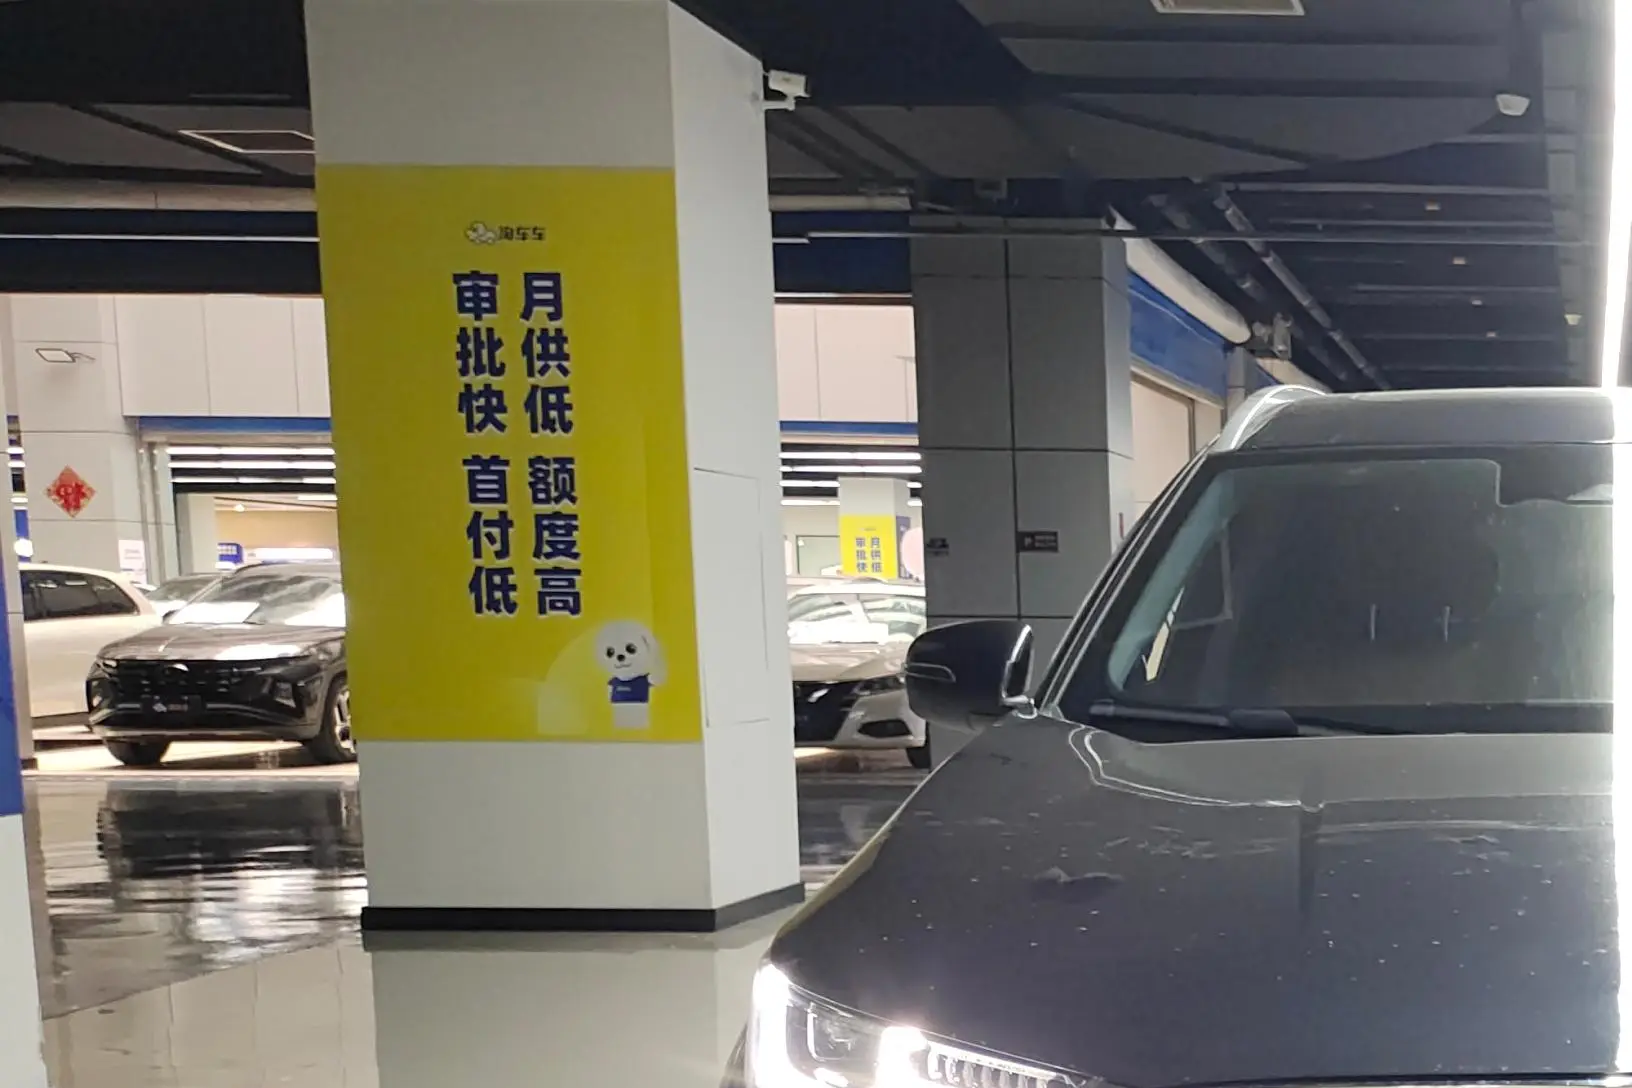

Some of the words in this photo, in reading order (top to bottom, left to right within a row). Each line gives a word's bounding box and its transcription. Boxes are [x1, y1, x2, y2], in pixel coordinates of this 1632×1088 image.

[452, 270, 508, 433] 审批快
[519, 272, 574, 434] 月供低
[462, 454, 518, 615] 首付低
[528, 455, 582, 616] 额度高
